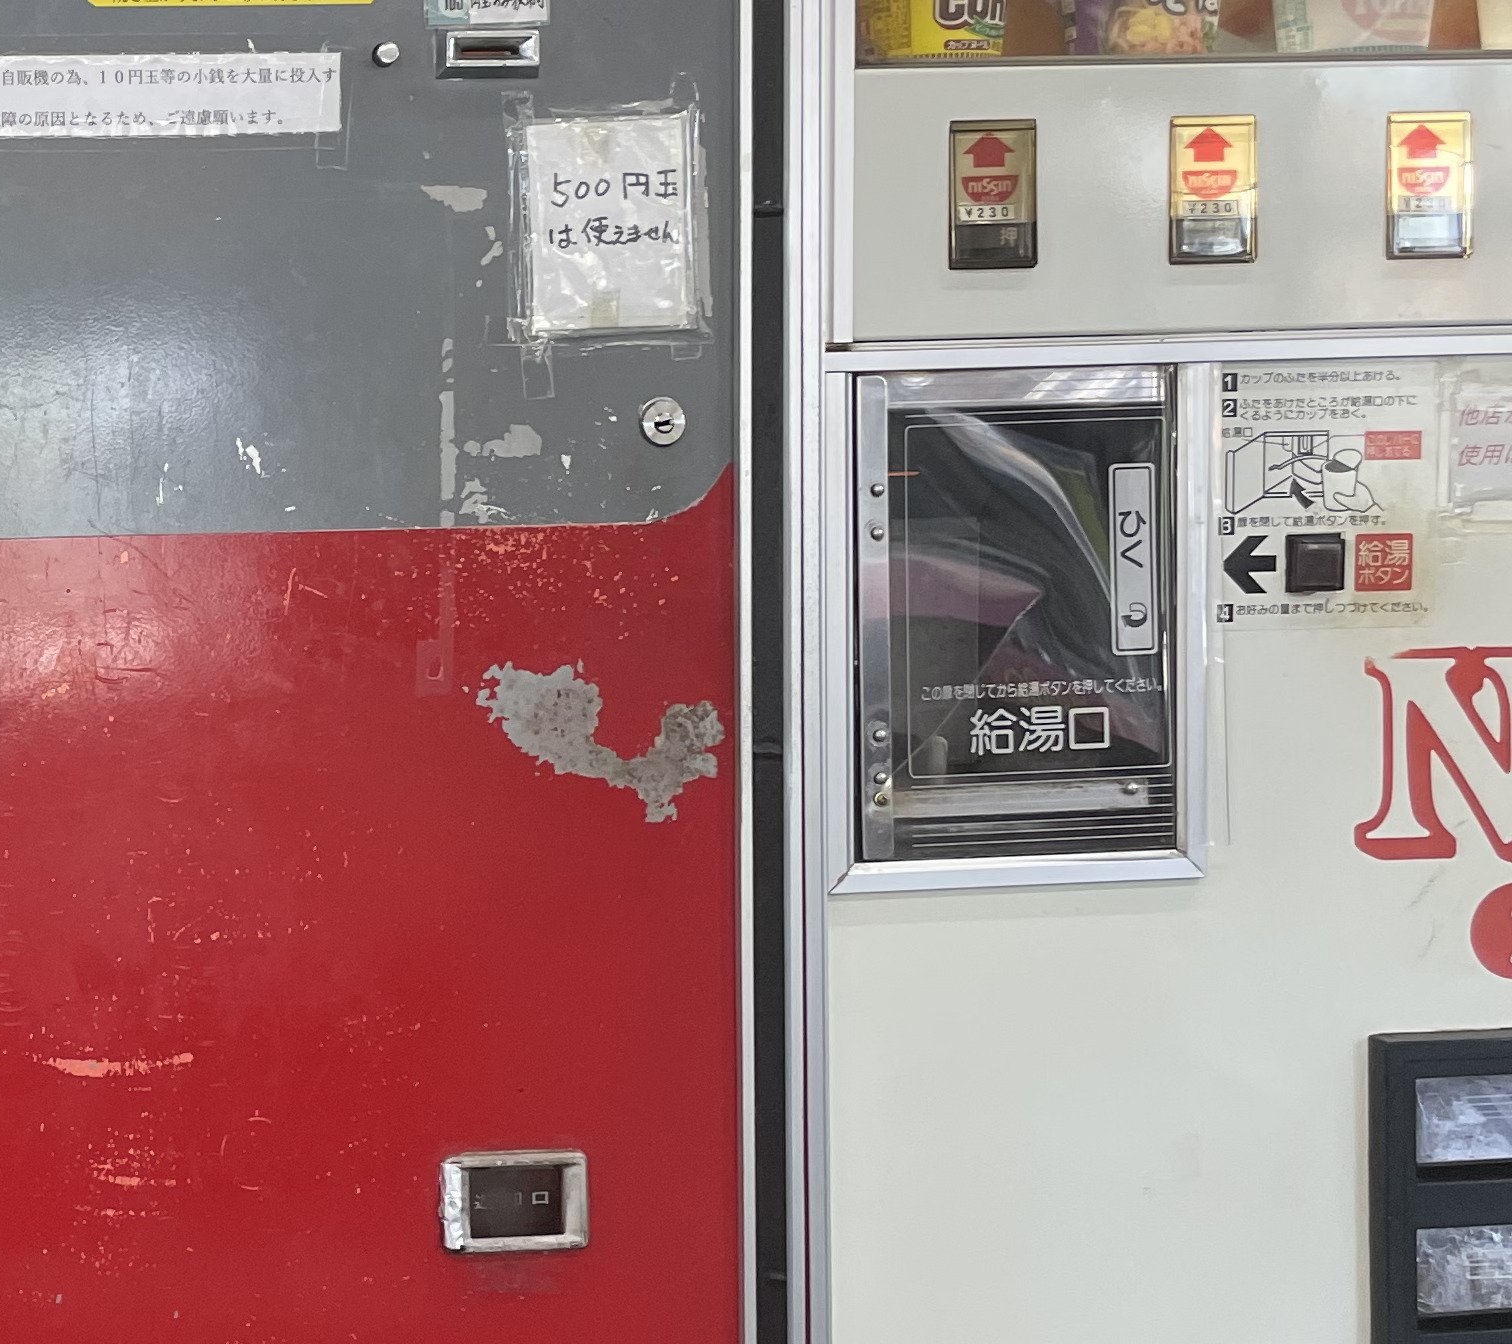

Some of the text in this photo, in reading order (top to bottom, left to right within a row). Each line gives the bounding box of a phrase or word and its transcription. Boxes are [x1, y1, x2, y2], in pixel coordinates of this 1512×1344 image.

[964, 206, 1010, 219] ¥230
[548, 216, 680, 249] は使えません
[1118, 510, 1147, 569] ひく
[1358, 539, 1410, 567] 給湯
[1358, 567, 1410, 585] ボタン
[969, 705, 1111, 756] 給湯口
